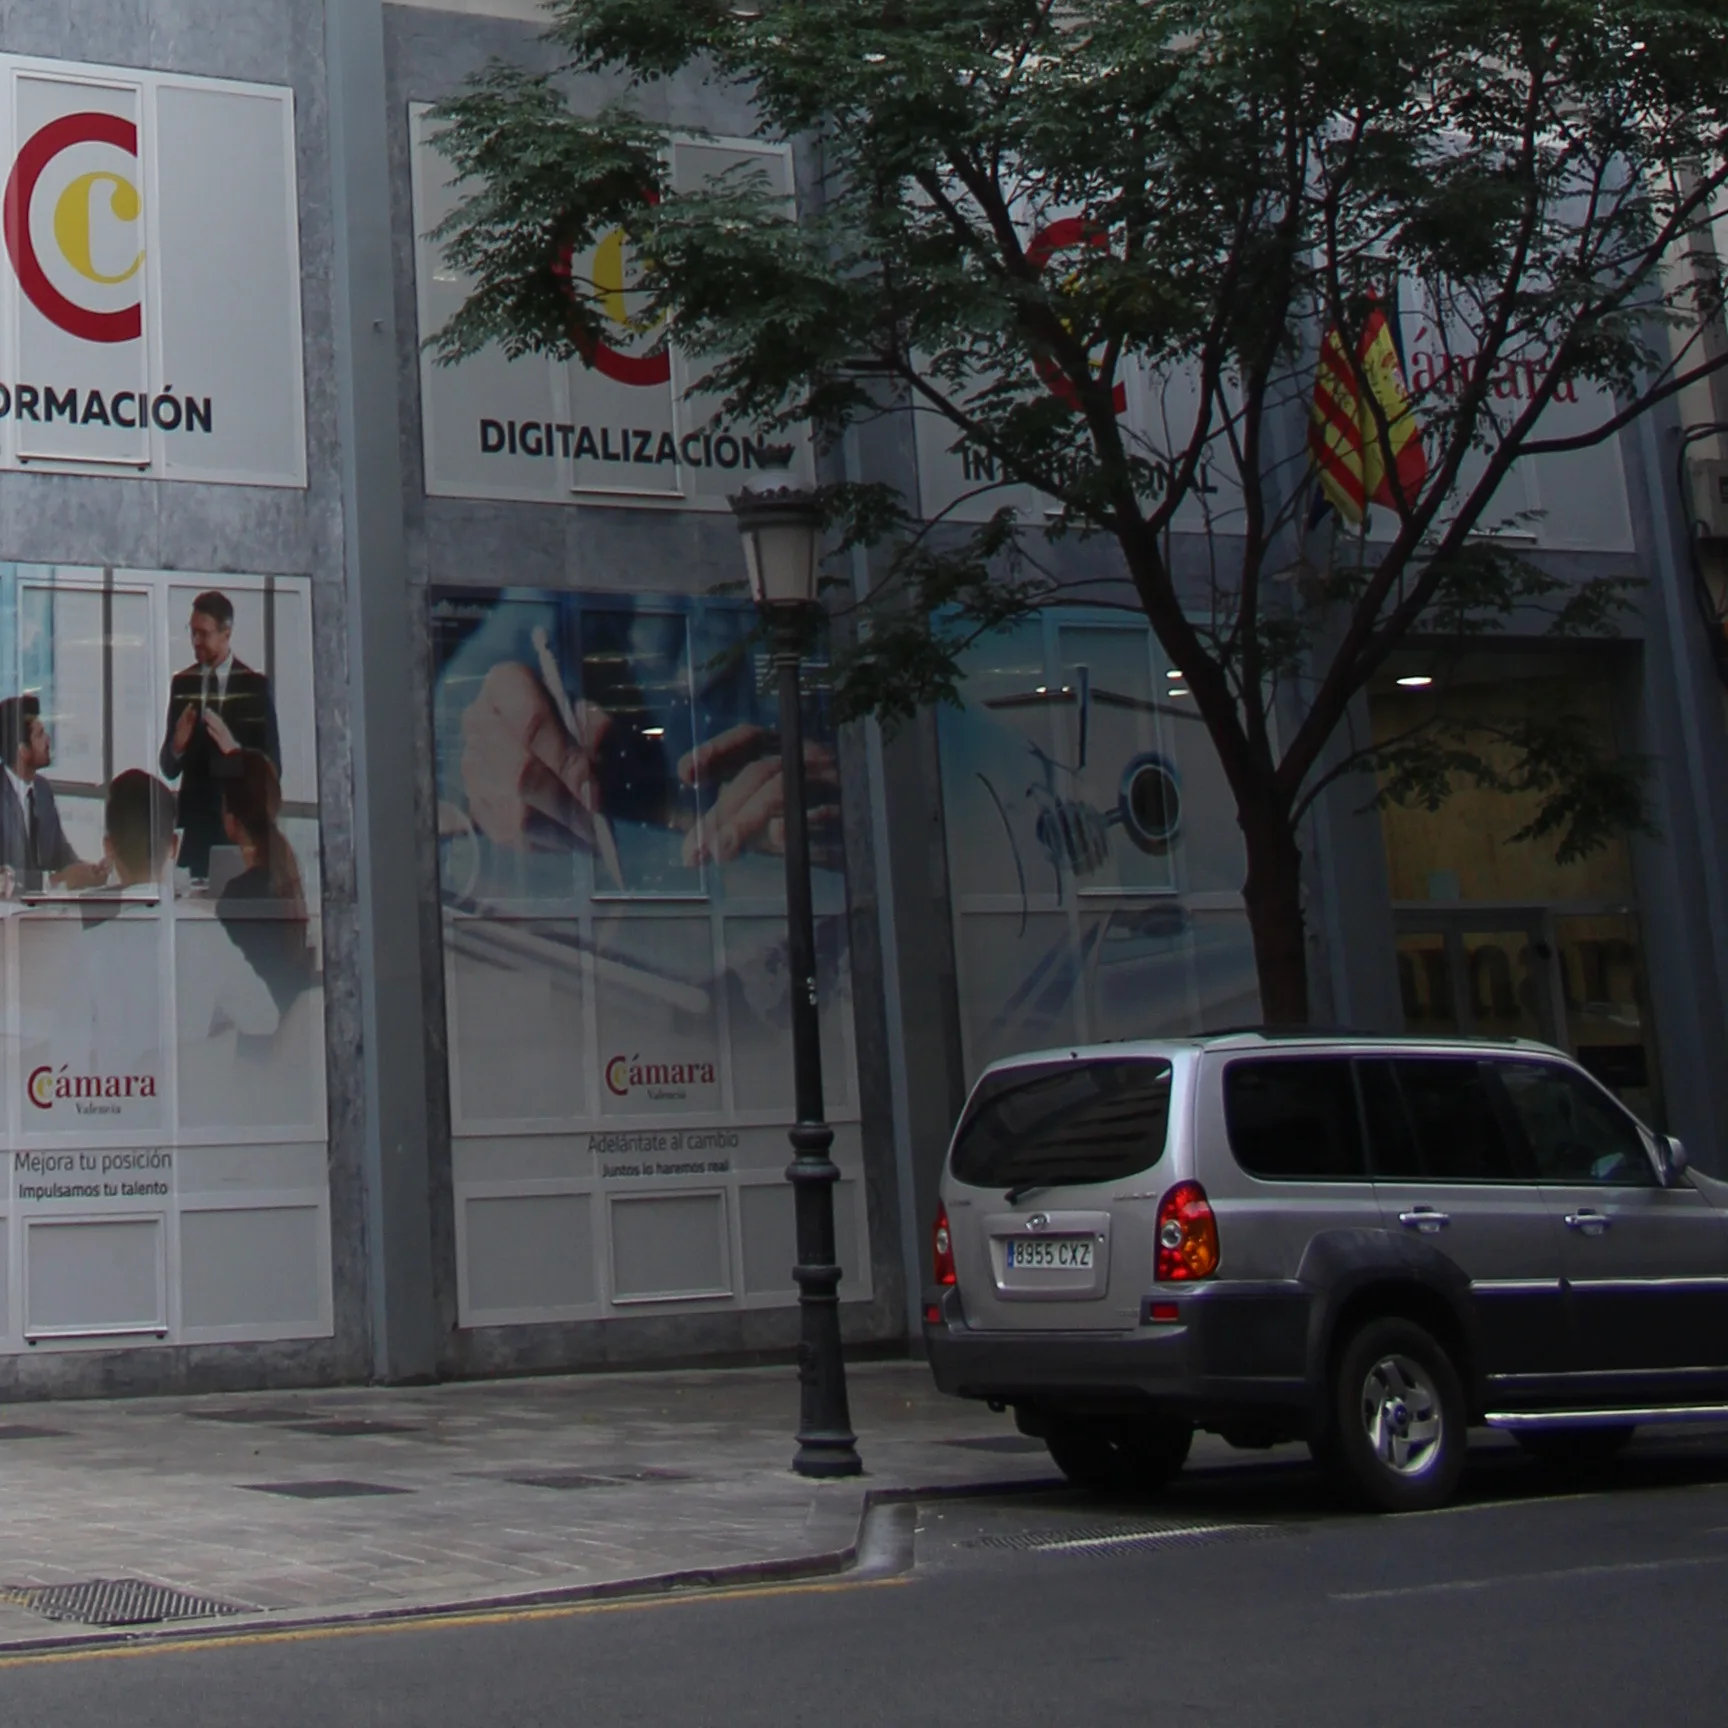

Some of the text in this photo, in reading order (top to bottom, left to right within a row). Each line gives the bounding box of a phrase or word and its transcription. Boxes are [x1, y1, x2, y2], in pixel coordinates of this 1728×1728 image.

[479, 419, 764, 469] DIGITALIZACIÓN
[28, 1064, 157, 1109] Cámara
[605, 1053, 716, 1096] Cámara
[75, 1102, 121, 1115] Valencia
[587, 1131, 739, 1153] Adelántate al cambio
[15, 1148, 172, 1176] Mejora tu posición
[603, 1159, 729, 1178] Juntos lo haremos real
[19, 1180, 168, 1202] Impulsamos tu talento
[1015, 1242, 1090, 1266] 8955 CXZ
